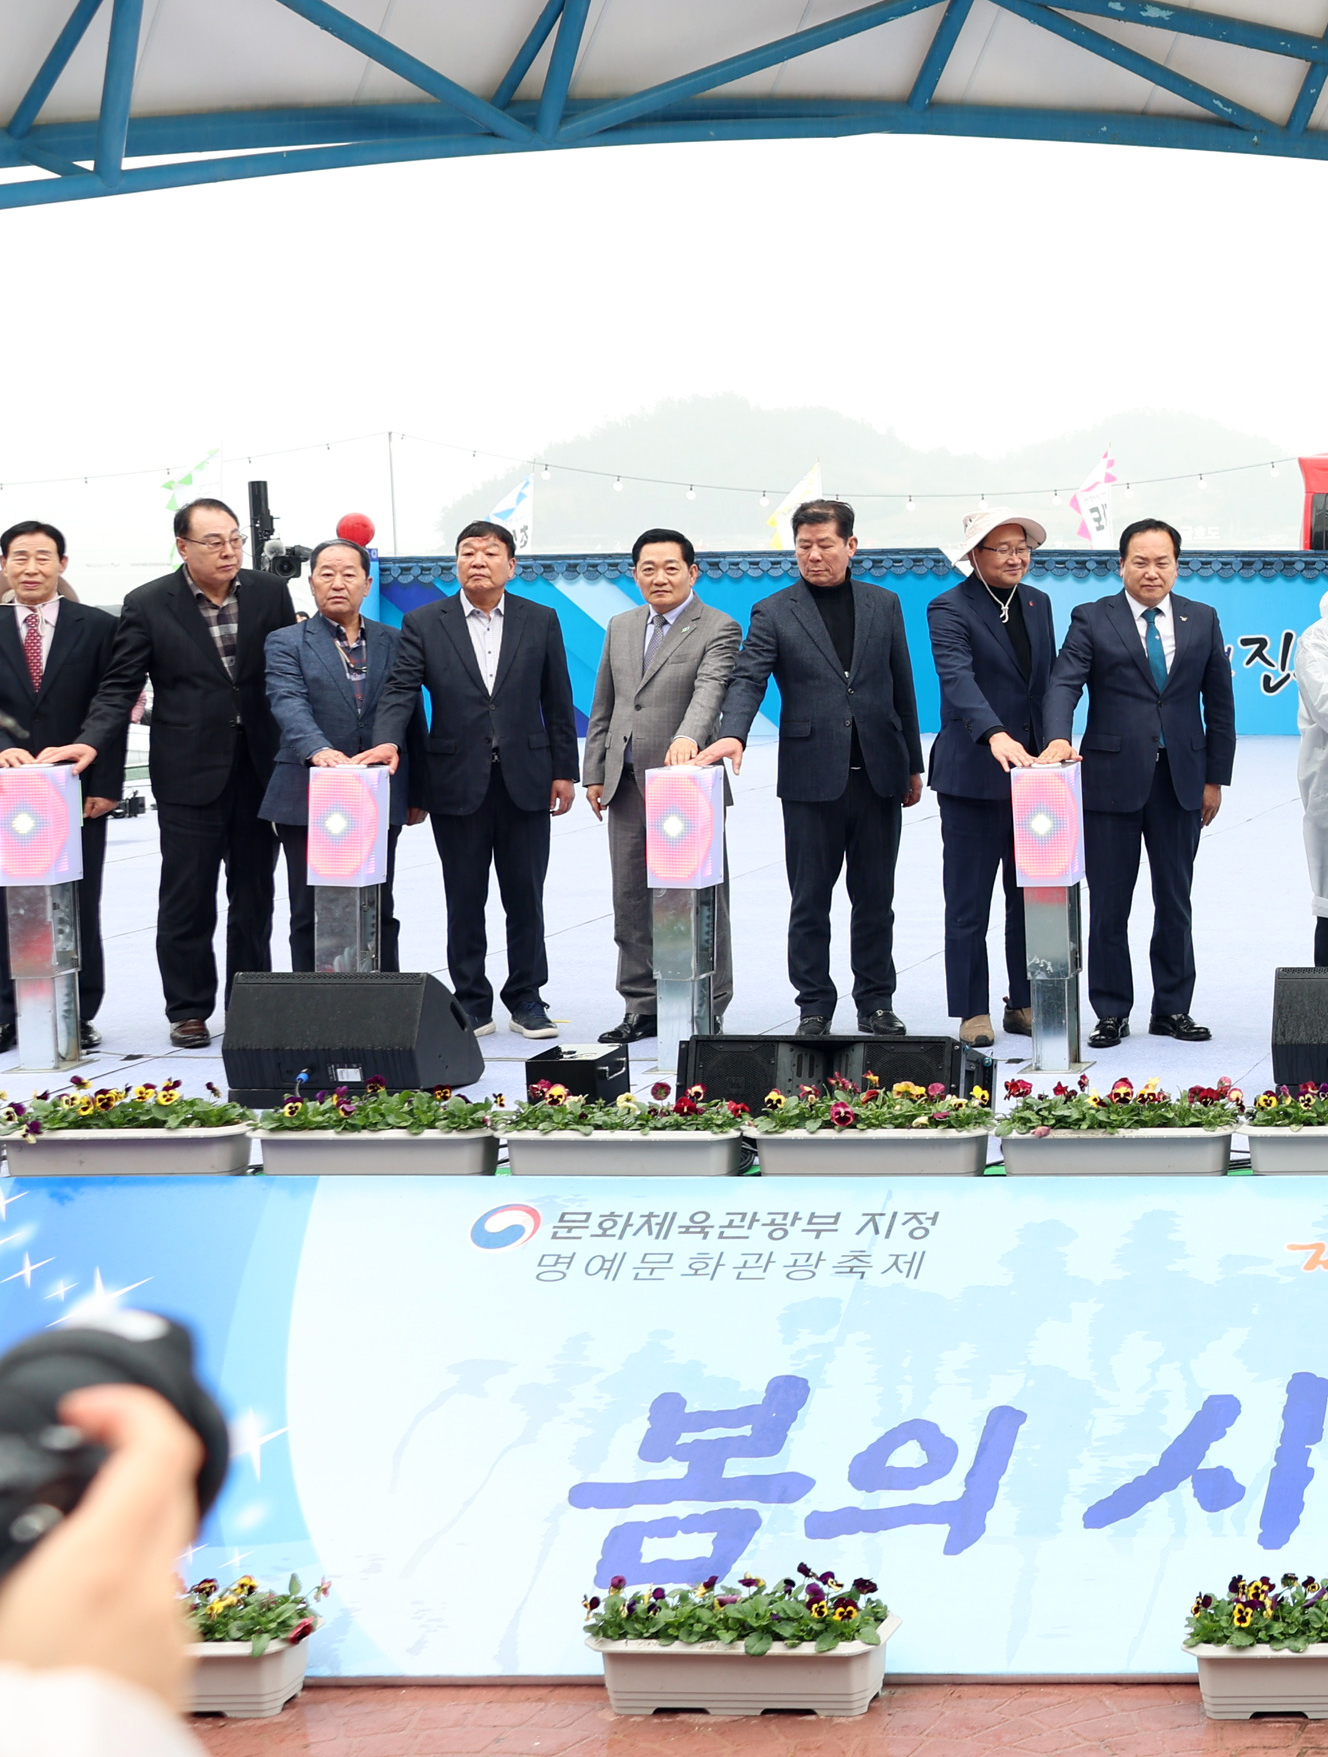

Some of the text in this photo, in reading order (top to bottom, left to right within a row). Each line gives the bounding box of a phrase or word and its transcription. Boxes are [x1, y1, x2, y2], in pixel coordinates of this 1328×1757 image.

[1239, 631, 1297, 694] 진
[550, 1210, 940, 1241] 문화체육관광부 지정
[535, 1250, 927, 1283] 명예문화관광축제
[568, 1374, 1028, 1589] 봄의
